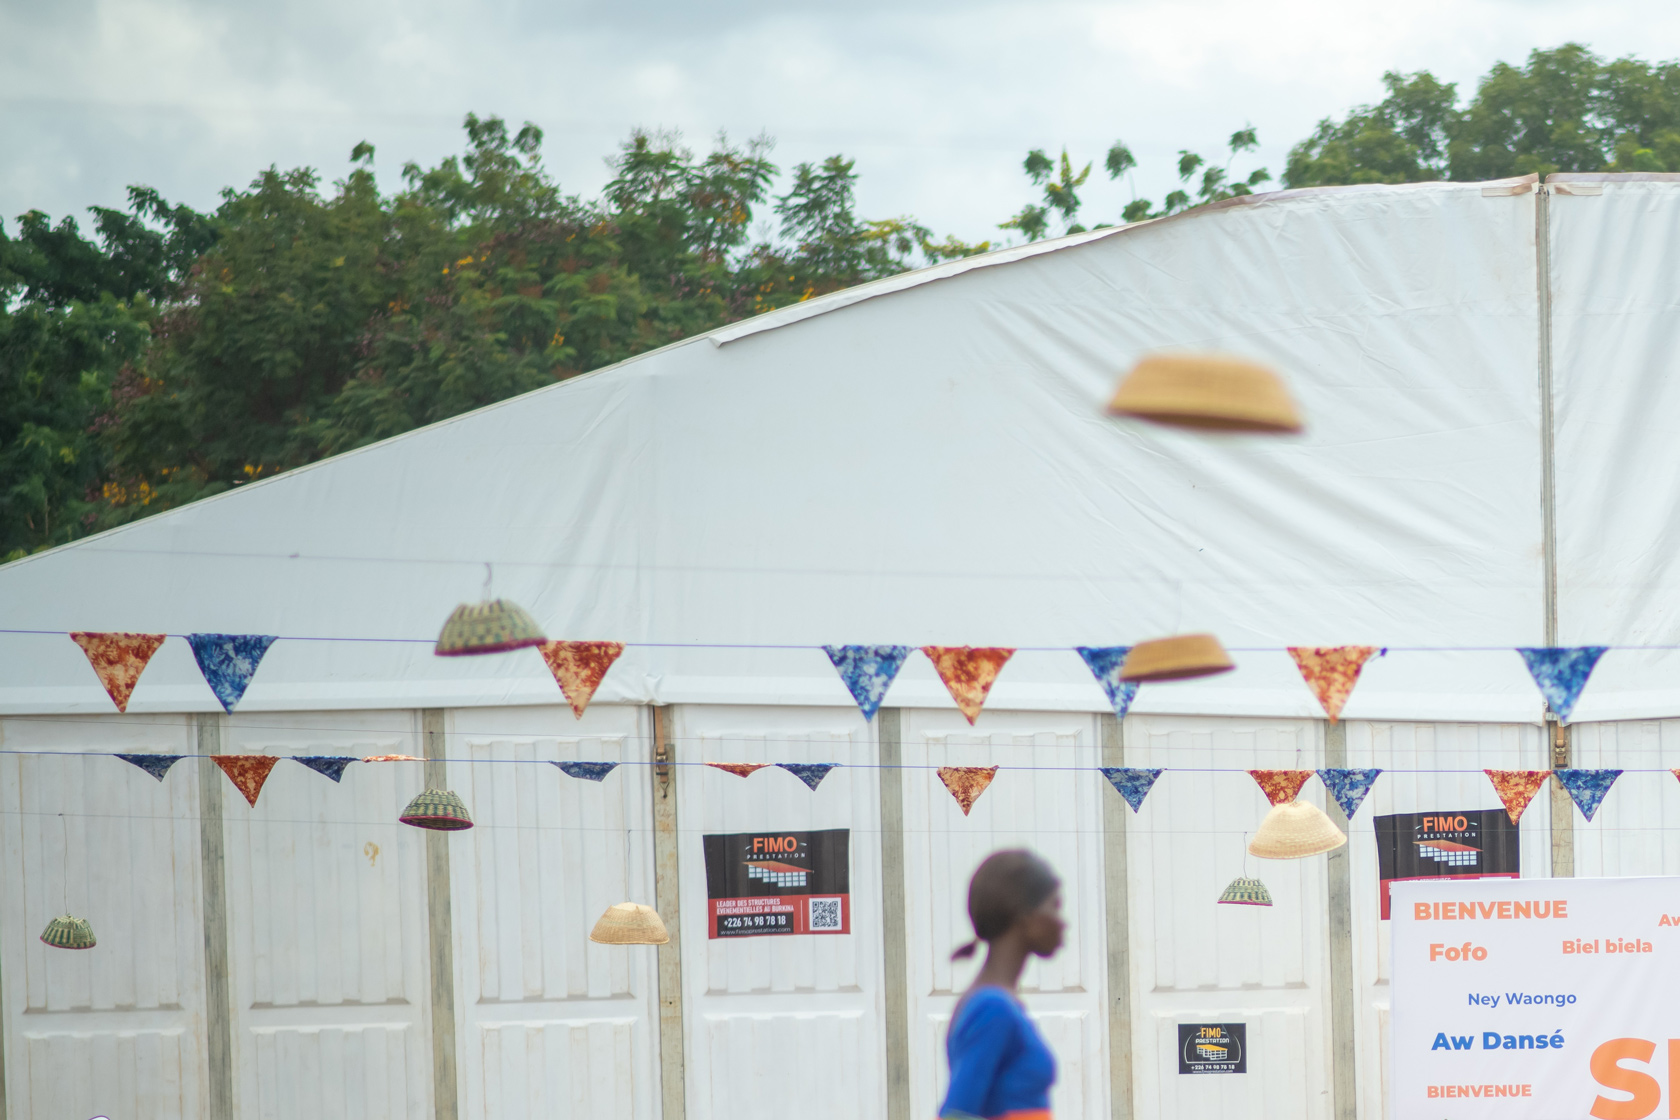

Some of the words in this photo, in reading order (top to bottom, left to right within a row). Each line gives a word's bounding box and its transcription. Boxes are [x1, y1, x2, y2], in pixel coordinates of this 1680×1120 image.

[1423, 816, 1468, 832] FIMO
[753, 837, 797, 853] FIMO
[1414, 900, 1568, 921] BIENVENUE
[724, 917, 742, 927] +226
[744, 917, 752, 926] 74
[755, 917, 764, 926] 98
[766, 916, 775, 925] 78
[778, 916, 786, 925] 18
[1429, 942, 1488, 962] Fofo
[1562, 938, 1599, 954] Biel
[1605, 937, 1653, 954] biela
[1468, 992, 1500, 1009] Ney
[1505, 992, 1577, 1009] Waongo
[1201, 1028, 1221, 1038] FIMO
[1431, 1033, 1475, 1051] Aw
[1482, 1028, 1565, 1051] Dansé
[1427, 1084, 1532, 1098] BIENVENUE
